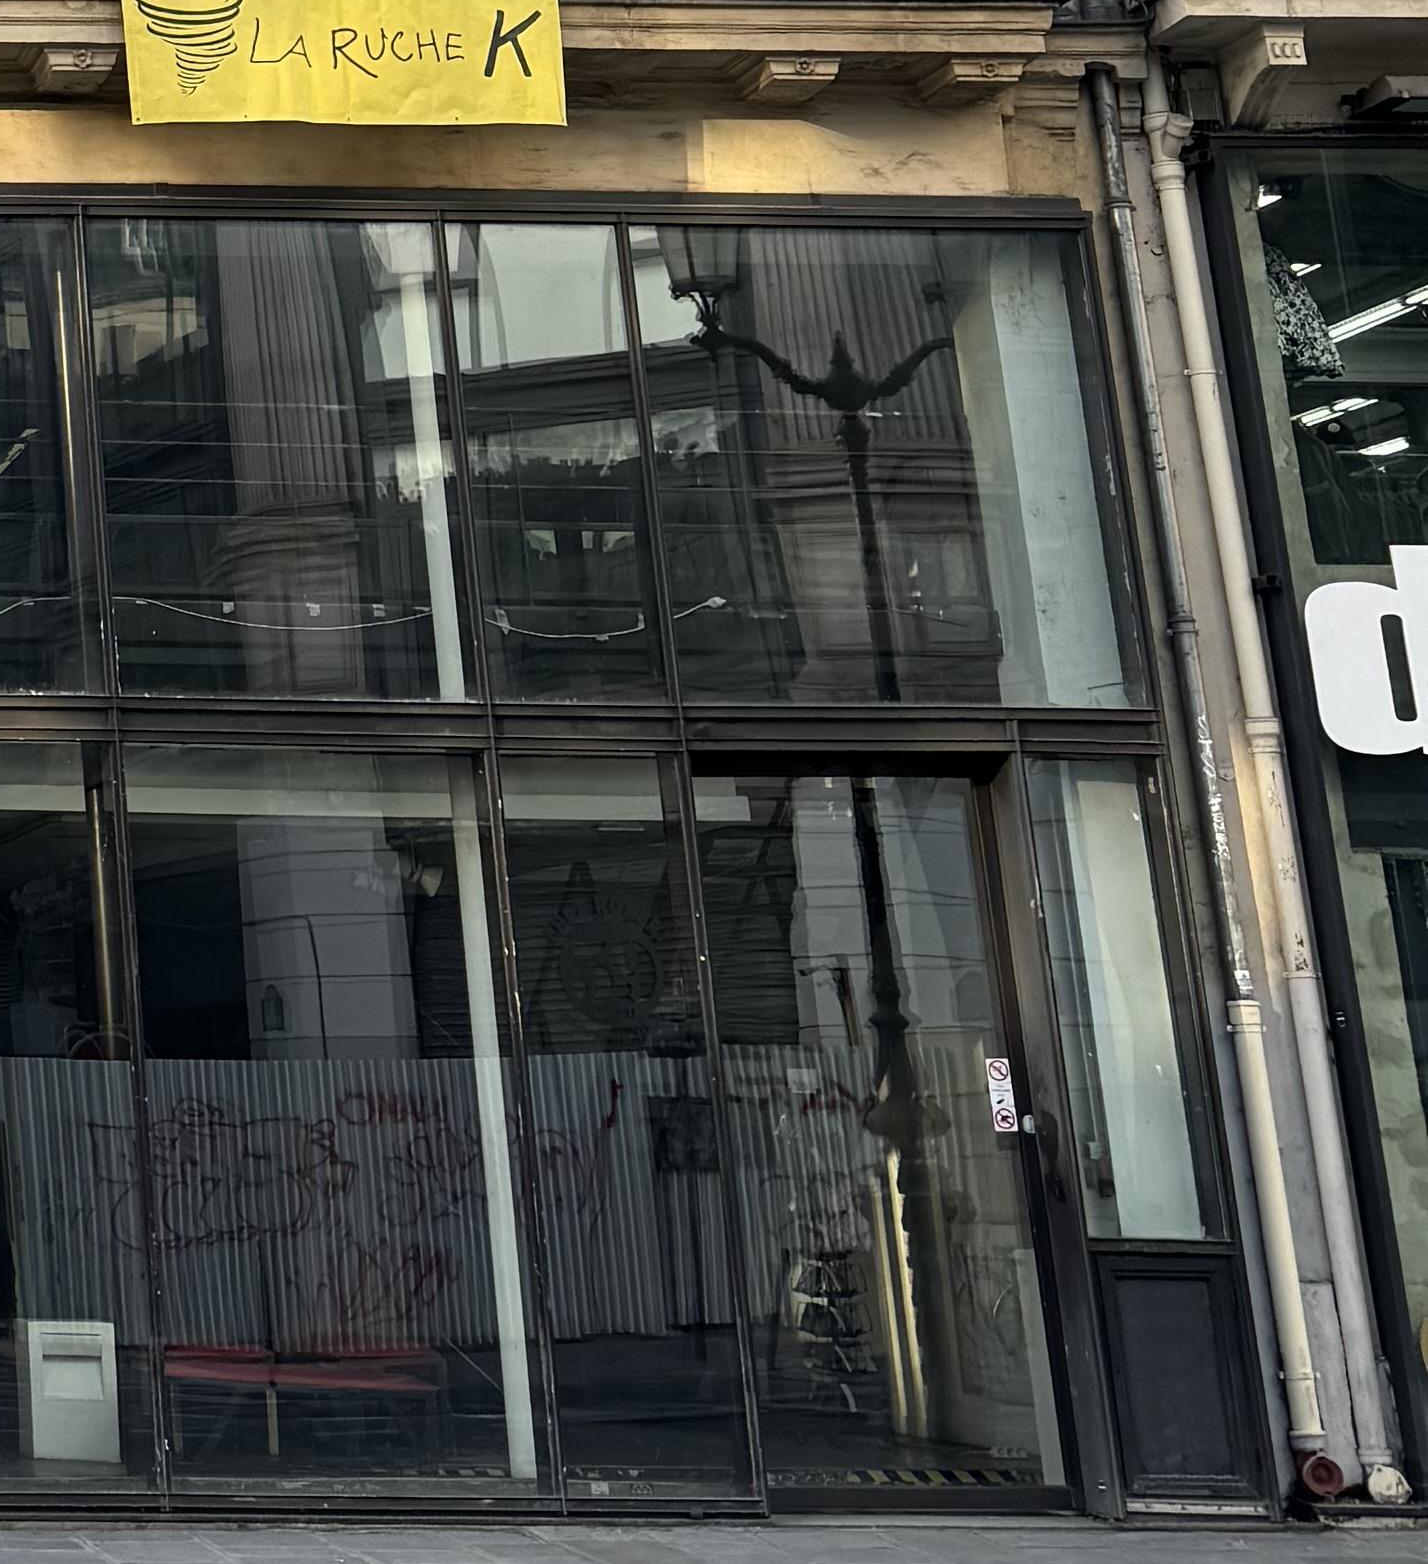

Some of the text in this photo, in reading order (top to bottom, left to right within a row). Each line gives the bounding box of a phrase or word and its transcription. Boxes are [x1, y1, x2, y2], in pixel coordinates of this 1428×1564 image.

[251, 10, 541, 78] LA RUCHE K
